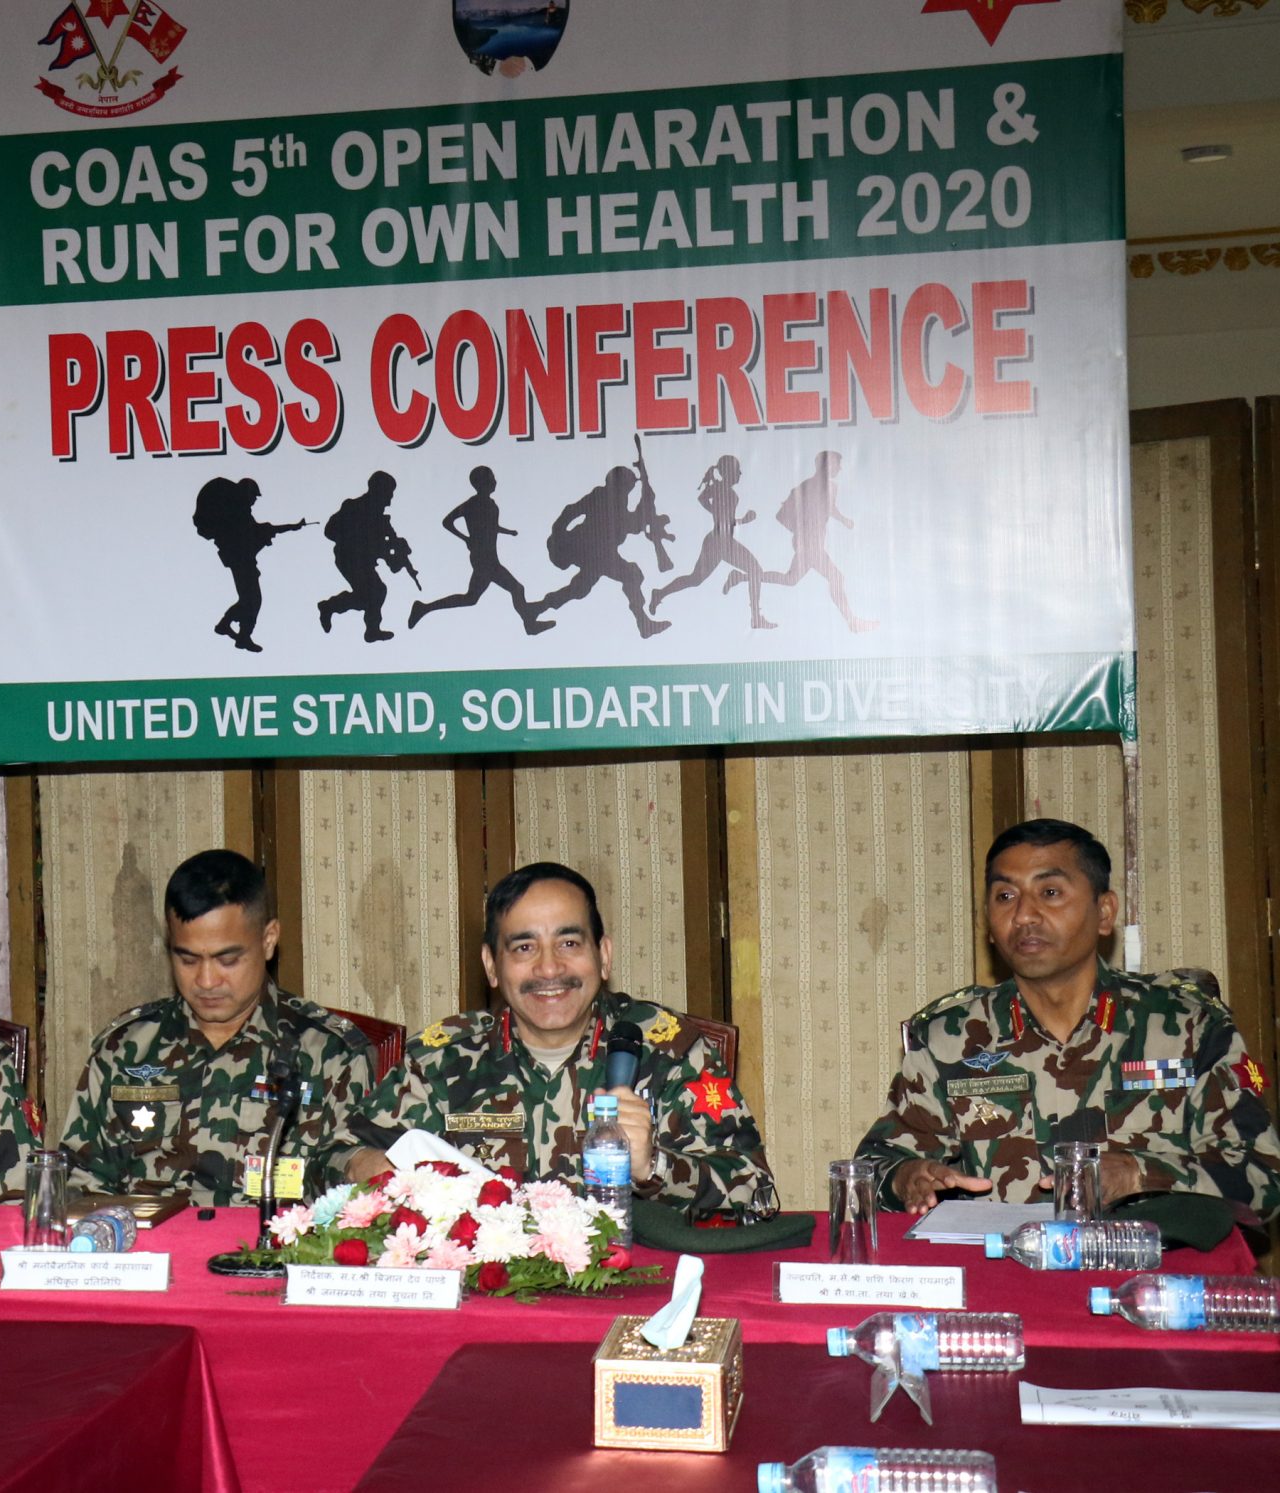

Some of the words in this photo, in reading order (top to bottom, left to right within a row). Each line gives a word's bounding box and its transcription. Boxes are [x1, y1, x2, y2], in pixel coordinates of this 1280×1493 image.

[30, 142, 208, 209] COAS
[231, 133, 308, 197] 5th
[331, 120, 517, 190] OPEN
[544, 88, 955, 177] MARATHON
[987, 82, 1040, 146] &
[42, 221, 180, 286] RUN
[205, 212, 340, 277] FOR
[361, 200, 519, 267] OWN
[547, 179, 830, 256] HEALTH
[856, 166, 1032, 238] 2020
[48, 317, 343, 461] PRESS
[370, 279, 1037, 447] CONFERENCE
[47, 697, 199, 741] UNITED
[211, 696, 279, 738] WE
[292, 691, 448, 741] STAND,
[461, 683, 730, 732] SOLIDARITY
[744, 680, 786, 726] IN
[803, 674, 1049, 723] DIVERSITY
